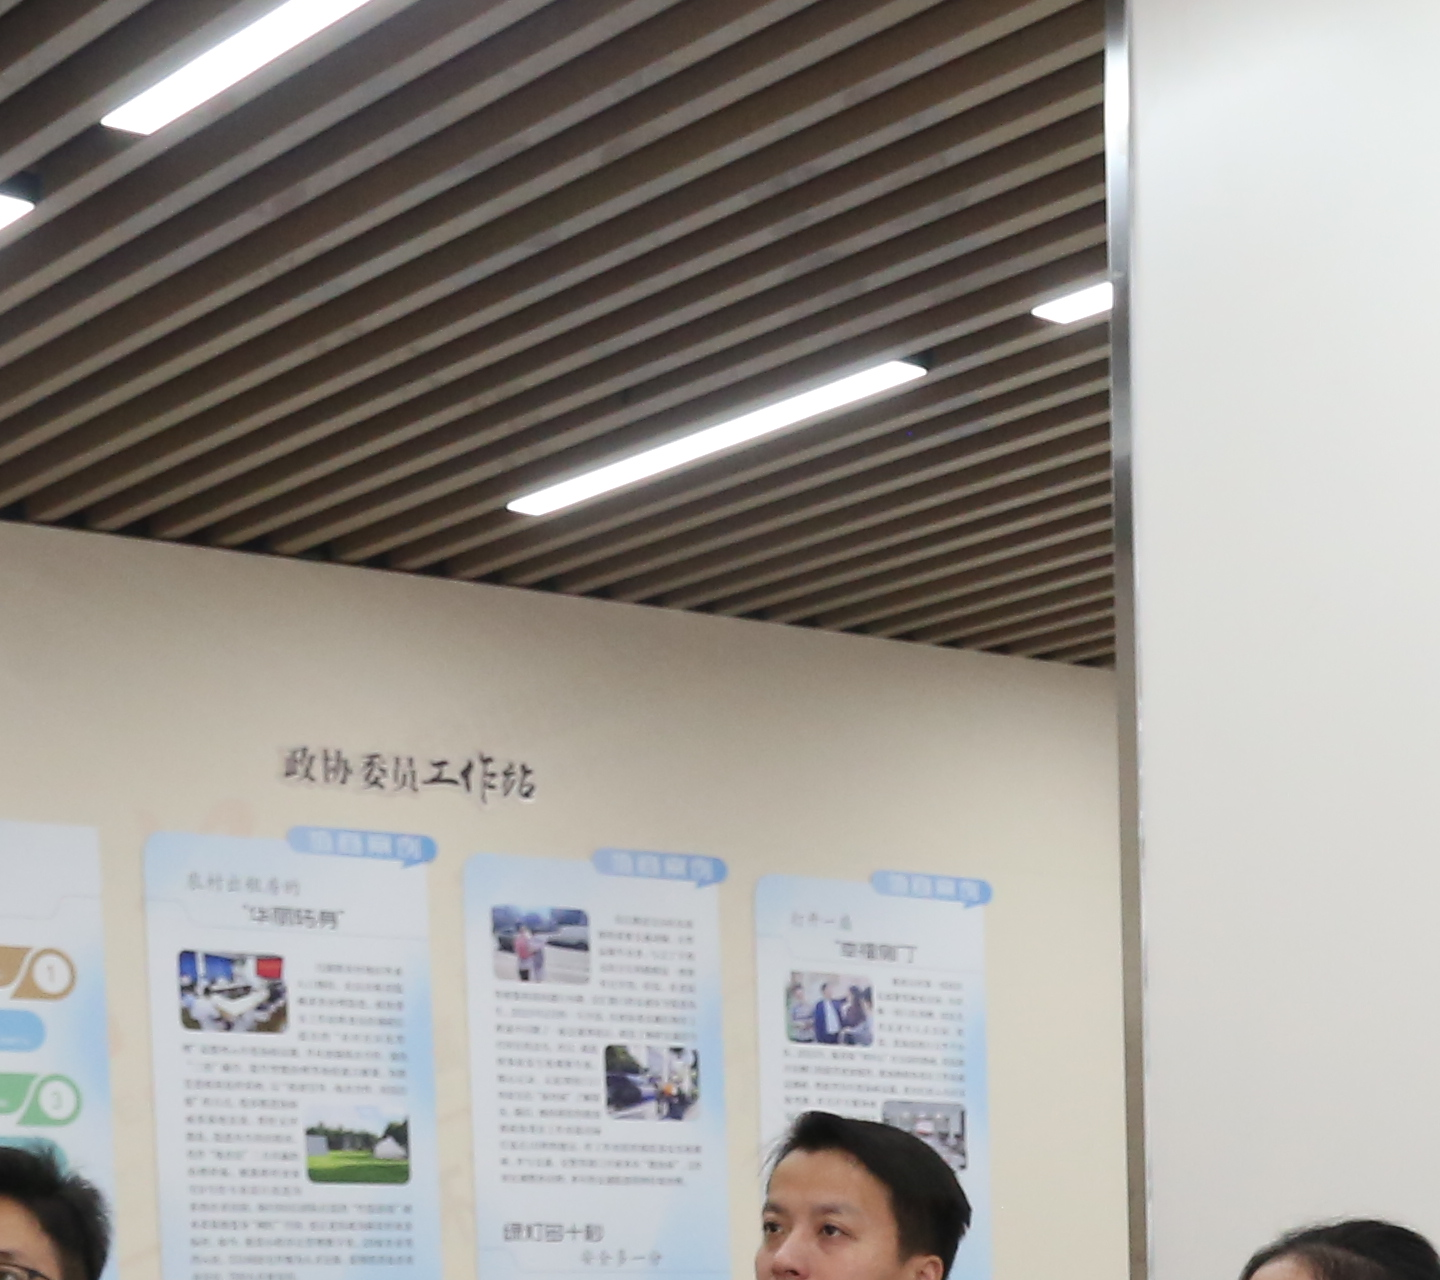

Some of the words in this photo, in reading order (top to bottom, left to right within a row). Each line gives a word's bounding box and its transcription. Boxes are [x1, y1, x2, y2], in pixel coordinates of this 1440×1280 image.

[283, 746, 537, 803] 政协委员工作站
